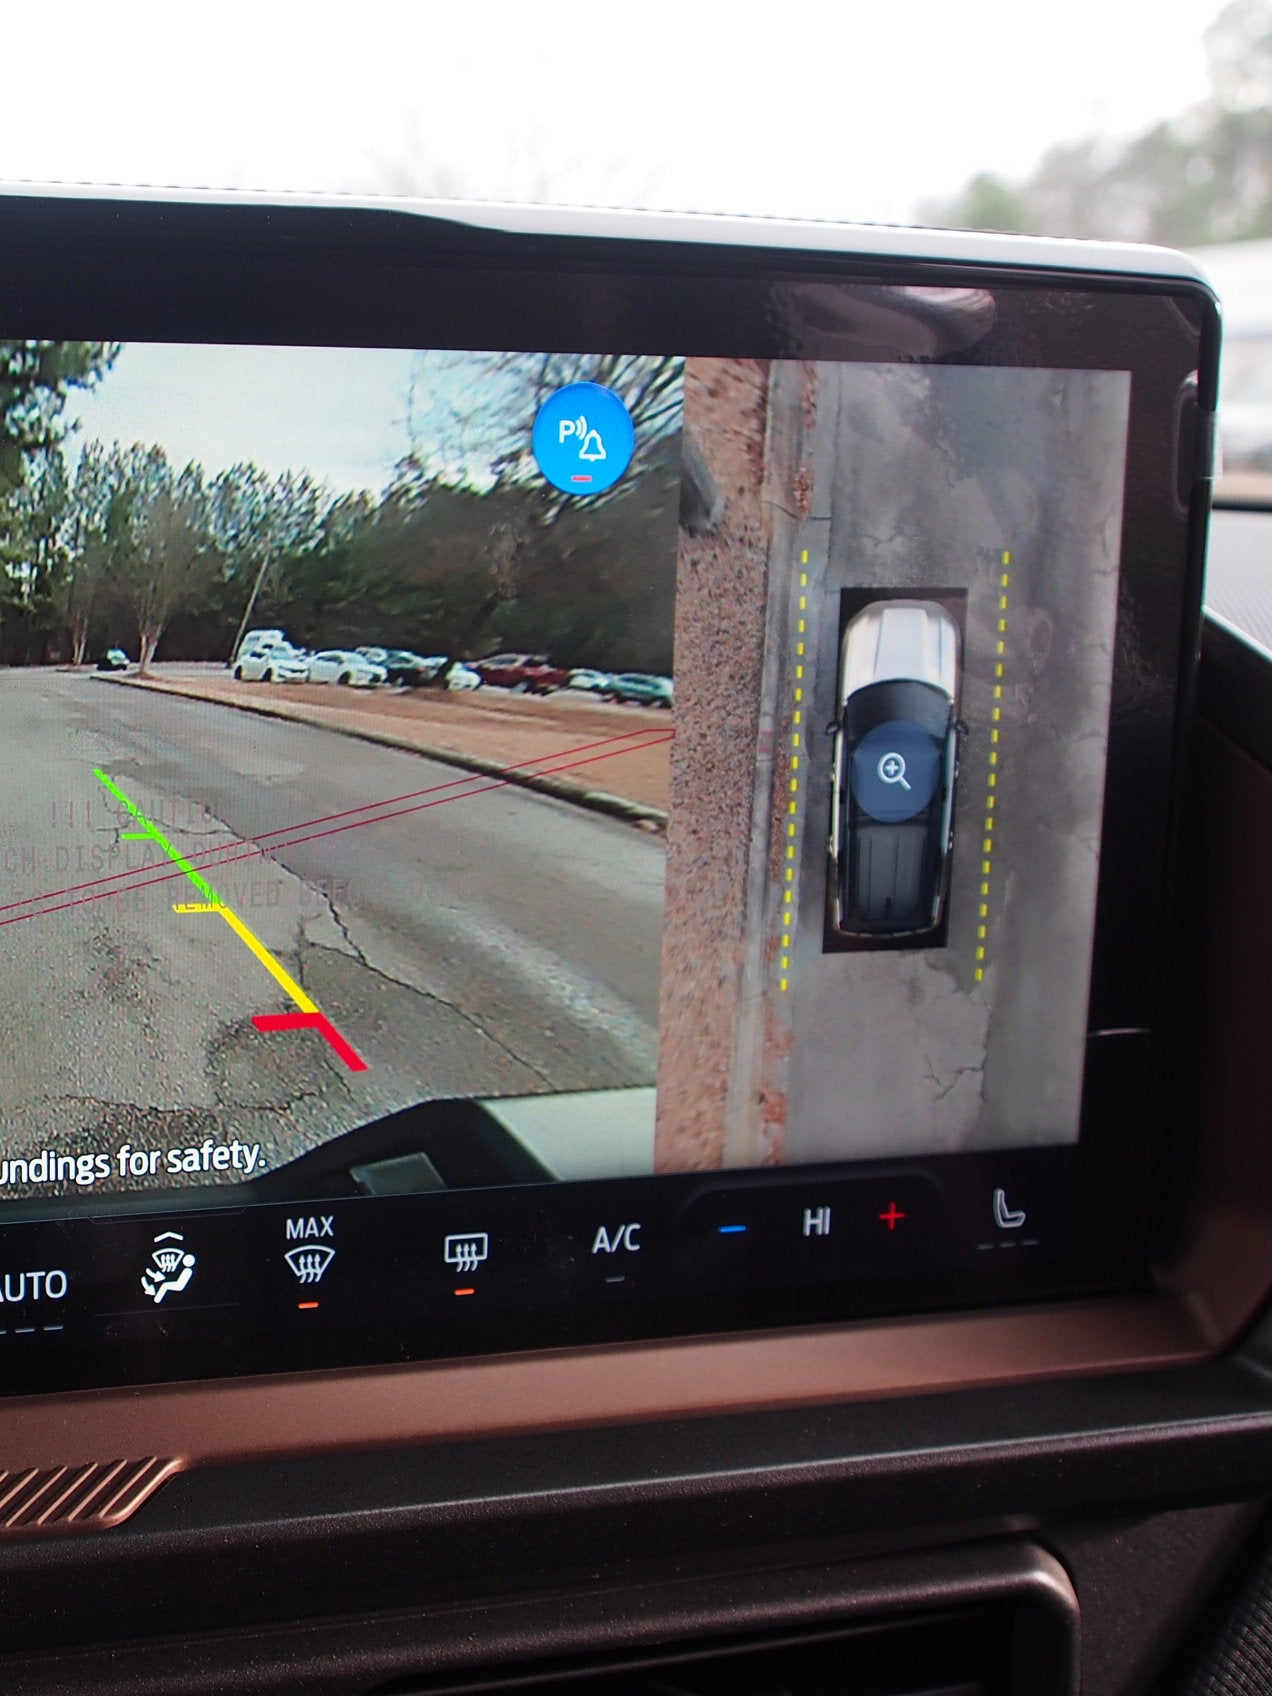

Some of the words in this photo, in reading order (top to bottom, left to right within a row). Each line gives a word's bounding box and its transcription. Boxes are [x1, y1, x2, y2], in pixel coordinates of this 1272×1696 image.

[116, 1145, 162, 1178] for
[166, 1138, 268, 1176] safety.
[286, 1215, 334, 1240] MAX
[804, 1208, 831, 1236] HI
[592, 1224, 641, 1254] A/C
